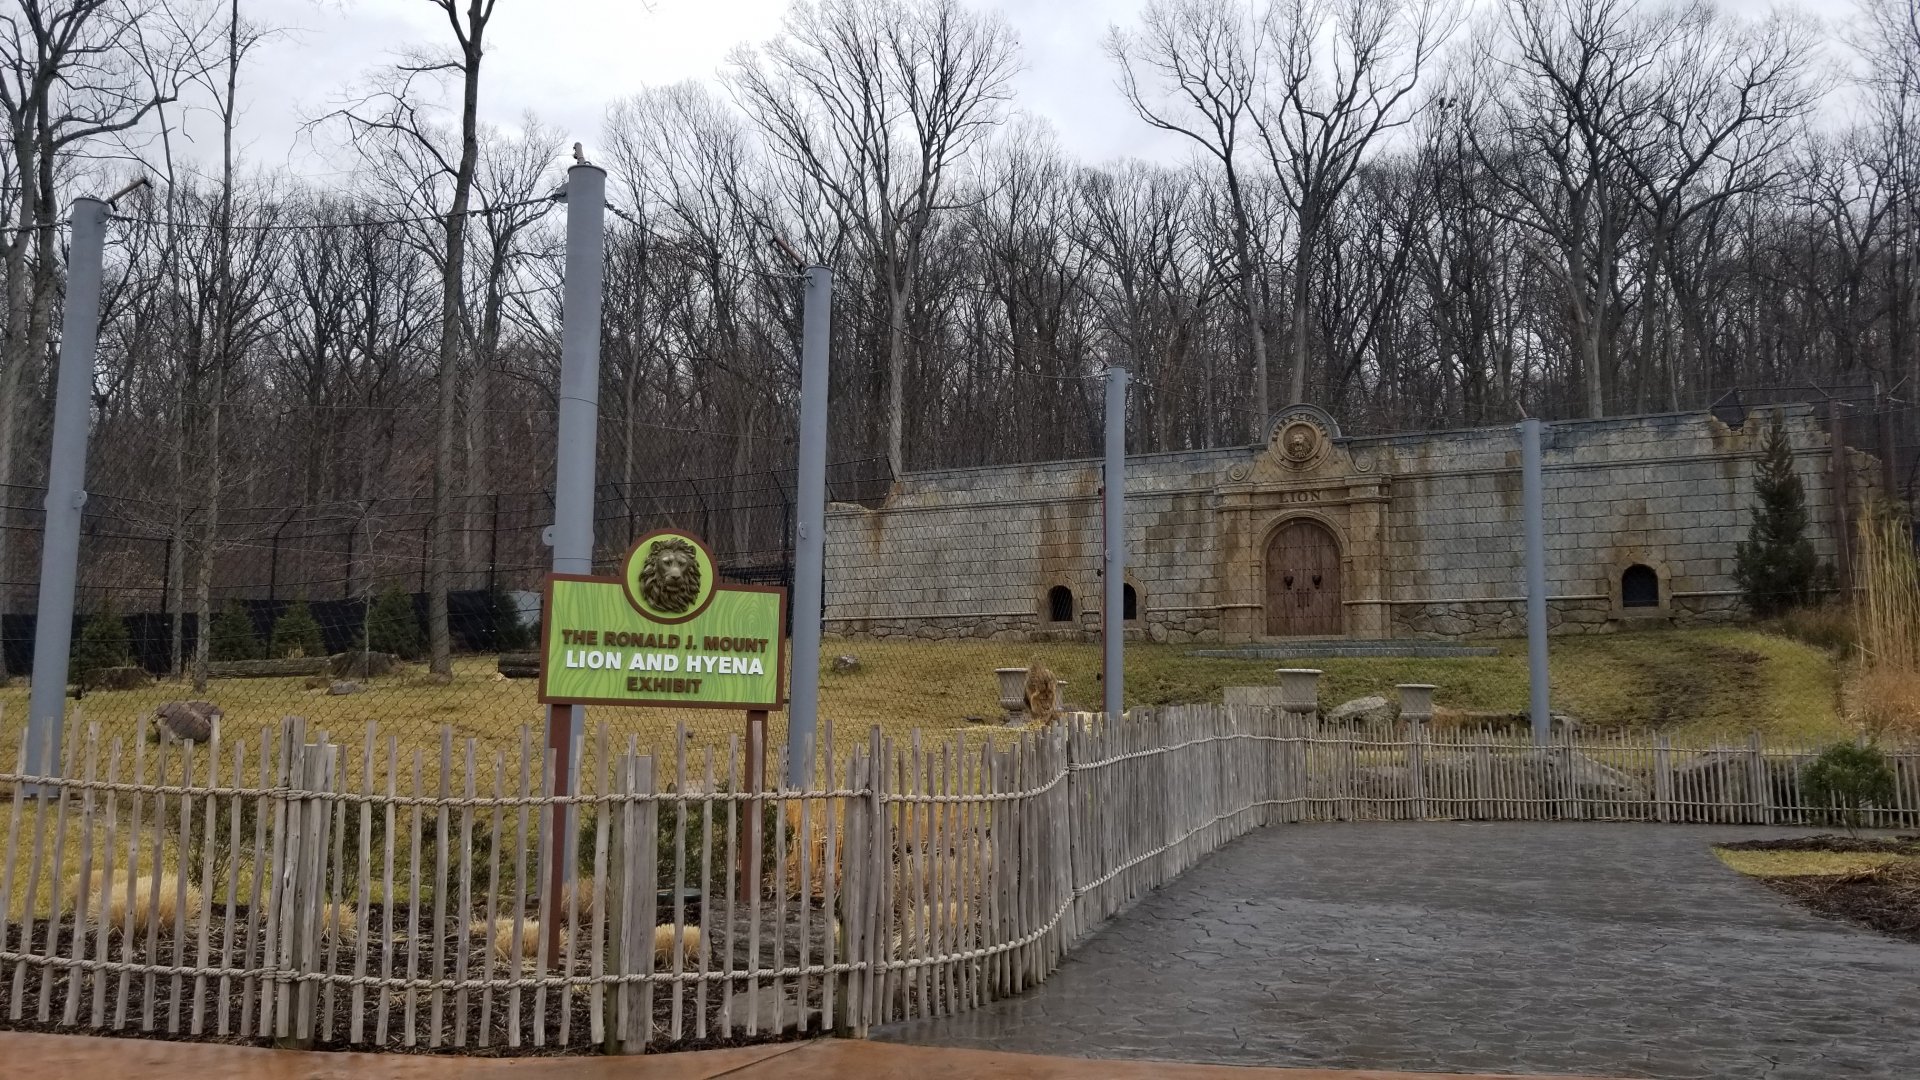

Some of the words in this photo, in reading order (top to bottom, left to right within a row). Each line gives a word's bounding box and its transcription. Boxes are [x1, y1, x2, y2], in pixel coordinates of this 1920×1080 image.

[1280, 491, 1321, 503] LION
[562, 629, 598, 646] THE
[604, 631, 681, 649] RONALD
[685, 635, 697, 650] J.
[703, 636, 769, 653] MOUNT
[566, 650, 622, 670] LION
[629, 653, 679, 673] AND
[686, 655, 764, 675] HYENA
[627, 676, 703, 694] EXHIBIT
